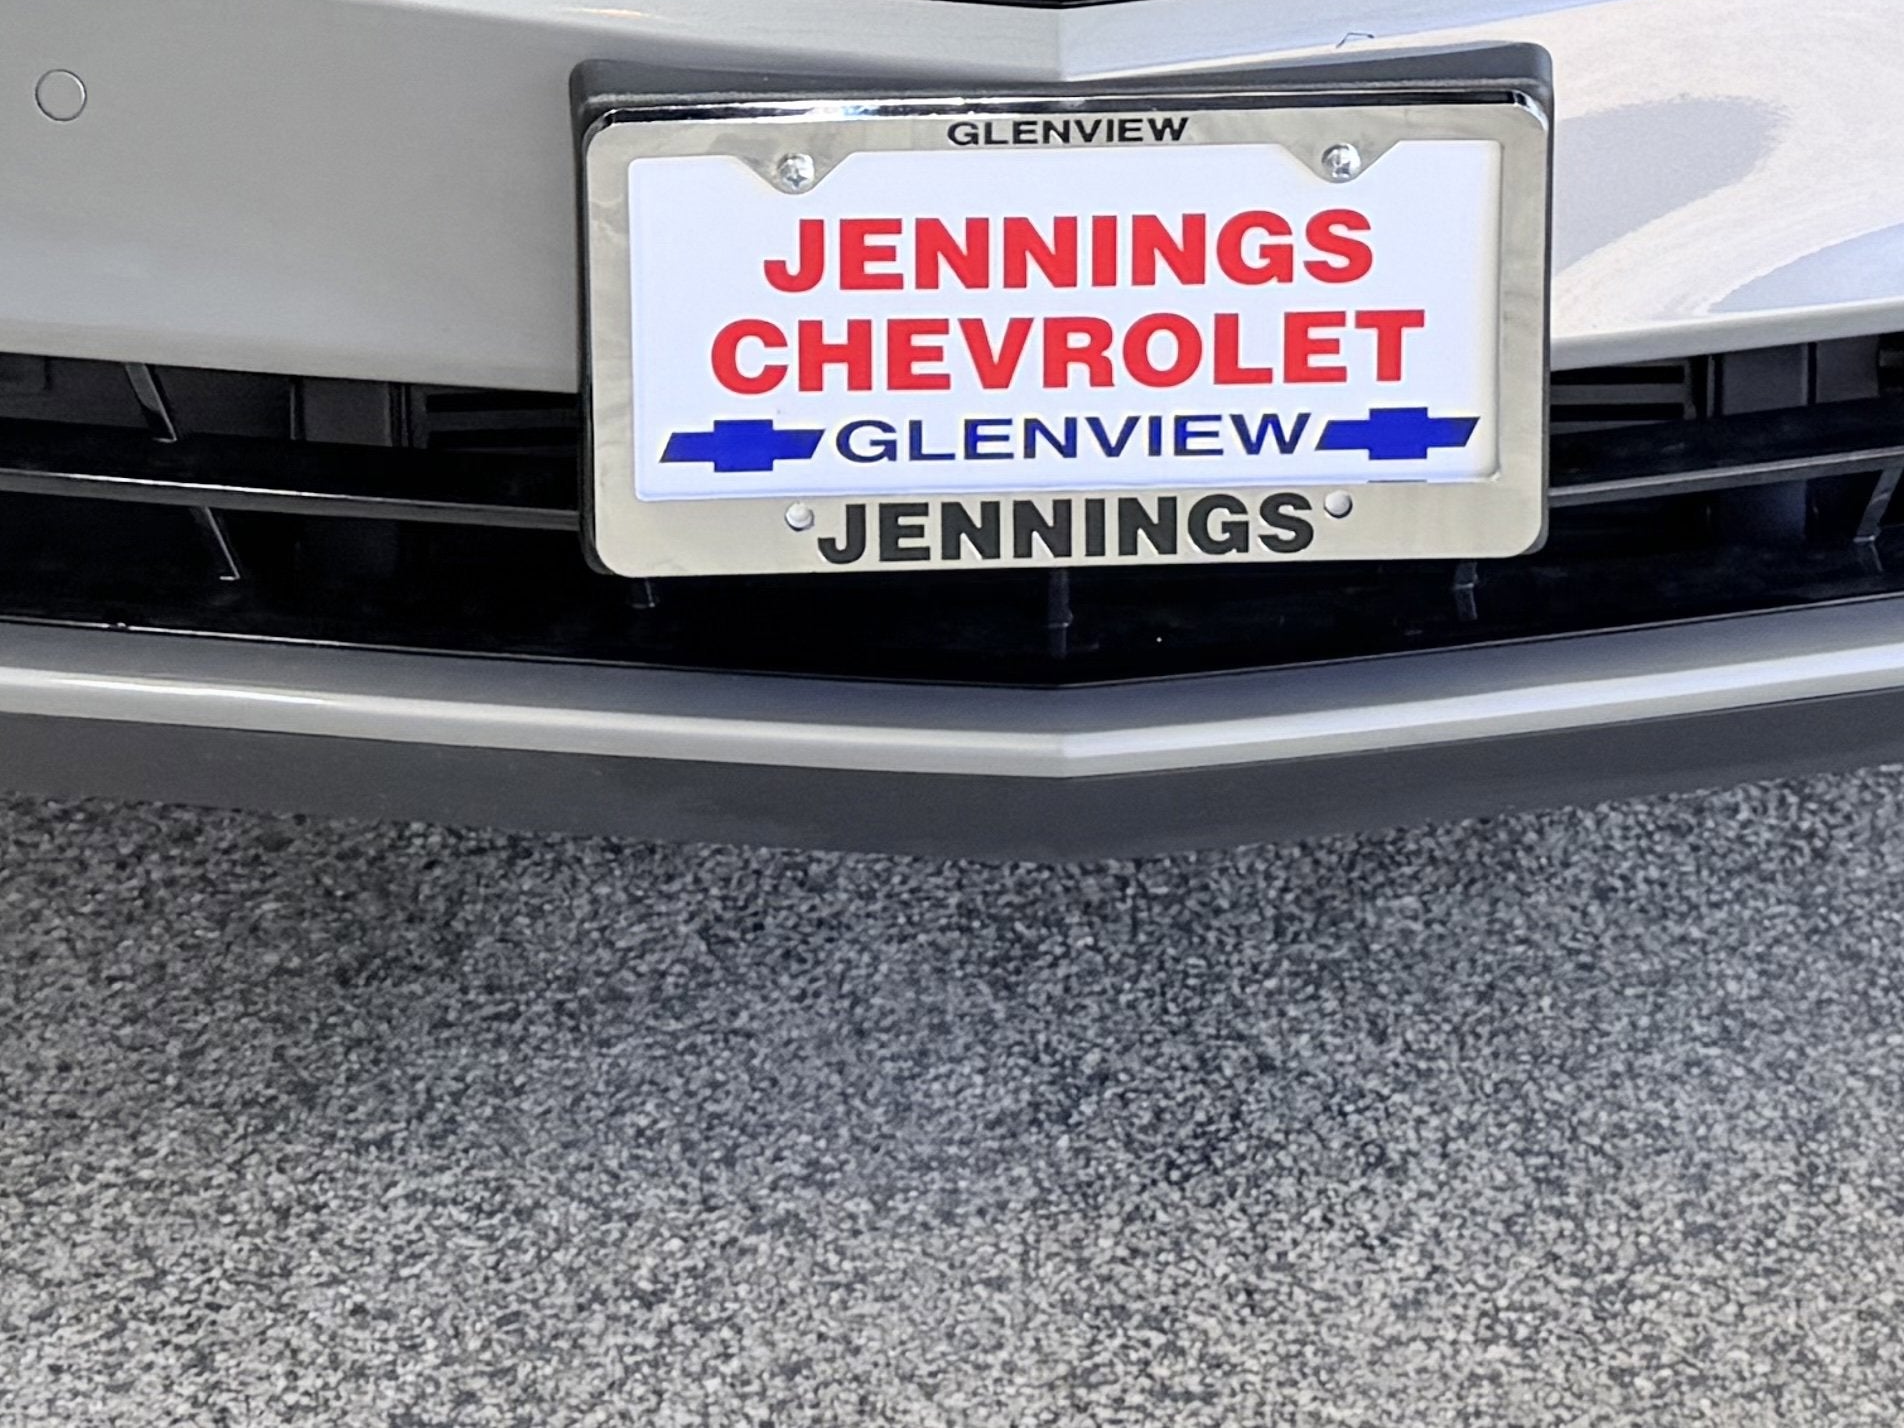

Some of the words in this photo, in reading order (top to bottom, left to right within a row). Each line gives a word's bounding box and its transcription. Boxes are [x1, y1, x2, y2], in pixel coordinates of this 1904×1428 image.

[947, 117, 1189, 145] GLENVIEW
[763, 210, 1373, 292] JENNINGS
[711, 310, 1425, 394] CHEVROLET
[836, 413, 1312, 462] GLENVIEW
[818, 493, 1314, 563] JENNINGS
